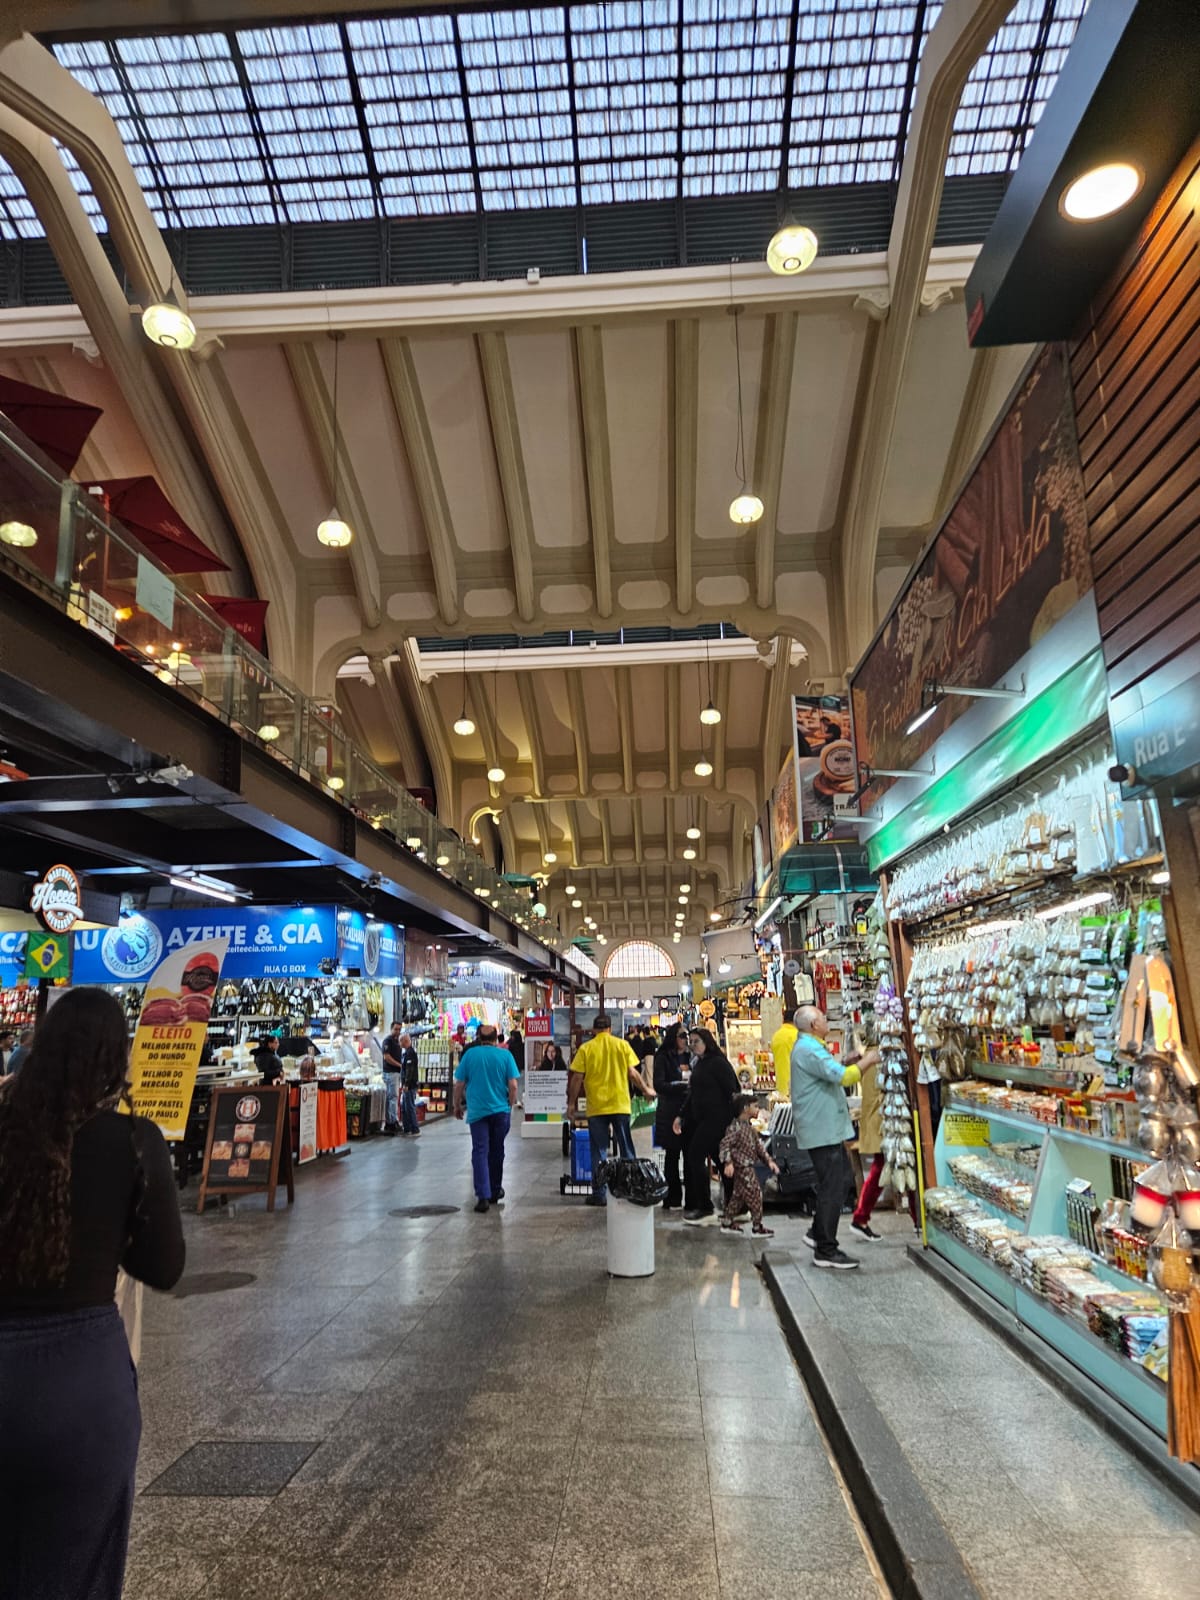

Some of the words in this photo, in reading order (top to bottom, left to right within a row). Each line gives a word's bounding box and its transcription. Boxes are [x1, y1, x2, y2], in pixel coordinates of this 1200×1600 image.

[957, 588, 988, 649] Cia
[996, 496, 1050, 602] Ltda
[1134, 731, 1169, 768] Rua
[166, 925, 246, 947] AZEITE
[254, 925, 273, 945] &
[281, 923, 323, 944] CIA
[264, 965, 280, 973] RUA
[290, 965, 306, 973] BOX
[152, 1027, 192, 1039] ELEITO
[141, 1042, 170, 1050] MELHOR
[172, 1042, 196, 1051] PASTEL
[148, 1052, 158, 1060] DO
[142, 1070, 171, 1078] MELHOR
[141, 1079, 180, 1088] MERCADÃO
[155, 1110, 179, 1118] PAULO
